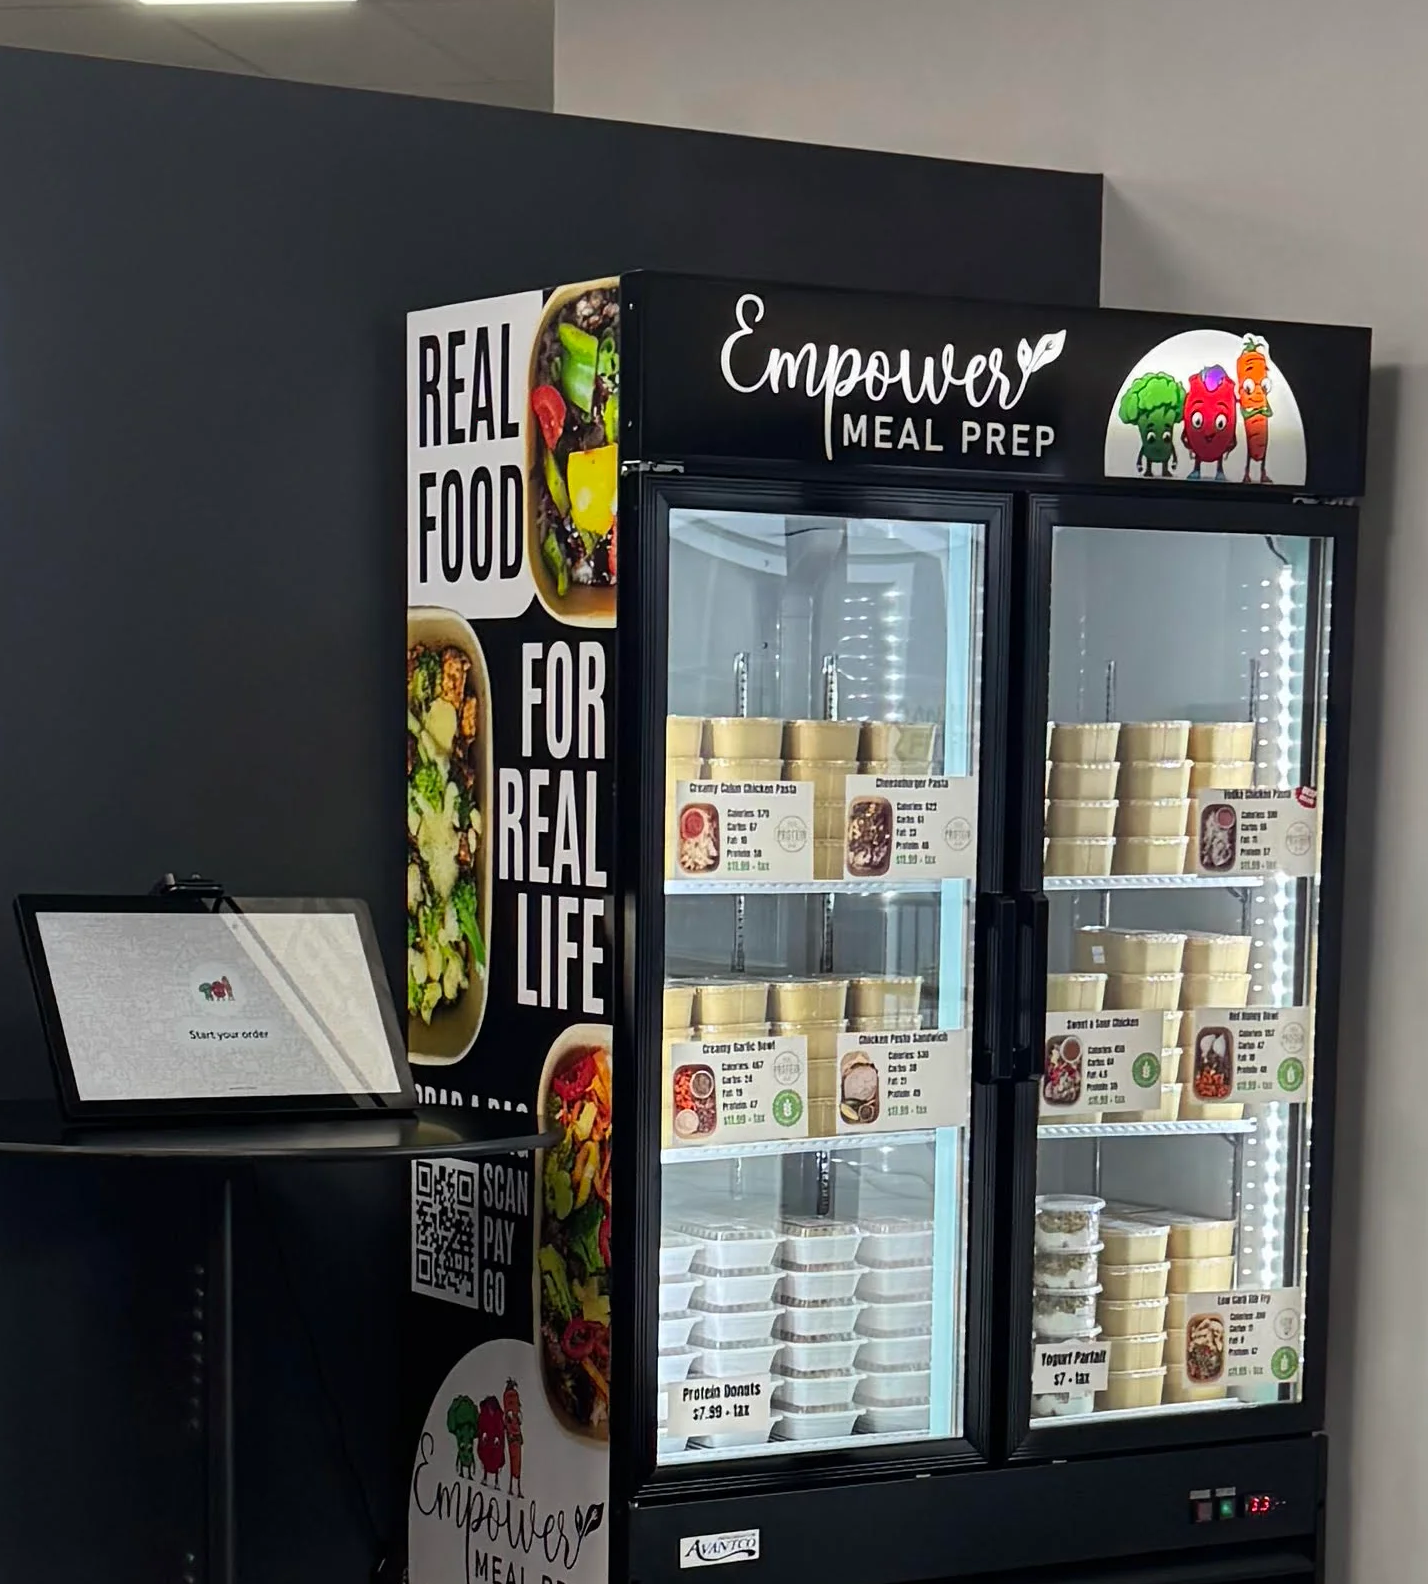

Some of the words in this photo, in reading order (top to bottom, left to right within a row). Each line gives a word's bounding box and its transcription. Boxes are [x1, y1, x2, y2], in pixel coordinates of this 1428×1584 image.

[419, 323, 519, 448] REAL
[721, 293, 1034, 460] Empower
[842, 414, 943, 451] MEAL
[961, 420, 1055, 457] PREP
[419, 464, 524, 584] FOOD
[521, 640, 606, 759] FOR
[776, 784, 797, 794] Pasta
[929, 779, 948, 788] Pasta
[498, 767, 607, 888] REAL
[517, 892, 605, 1015] LIFE
[188, 1029, 215, 1040] Start
[217, 1031, 239, 1041] your
[241, 1029, 269, 1039] order
[702, 1044, 731, 1054] Creamy
[758, 1040, 775, 1051] Bowl
[483, 1162, 528, 1217] SCAN
[483, 1215, 515, 1266] PAY
[483, 1268, 505, 1316] GO
[1041, 1352, 1073, 1367] Yogurt
[1073, 1350, 1107, 1365] Parfait
[1054, 1372, 1066, 1386] $7
[1075, 1371, 1090, 1384] tax
[682, 1384, 721, 1402] Protein
[724, 1382, 761, 1398] Donuts
[693, 1404, 722, 1420] $7.99
[733, 1403, 750, 1417] tax
